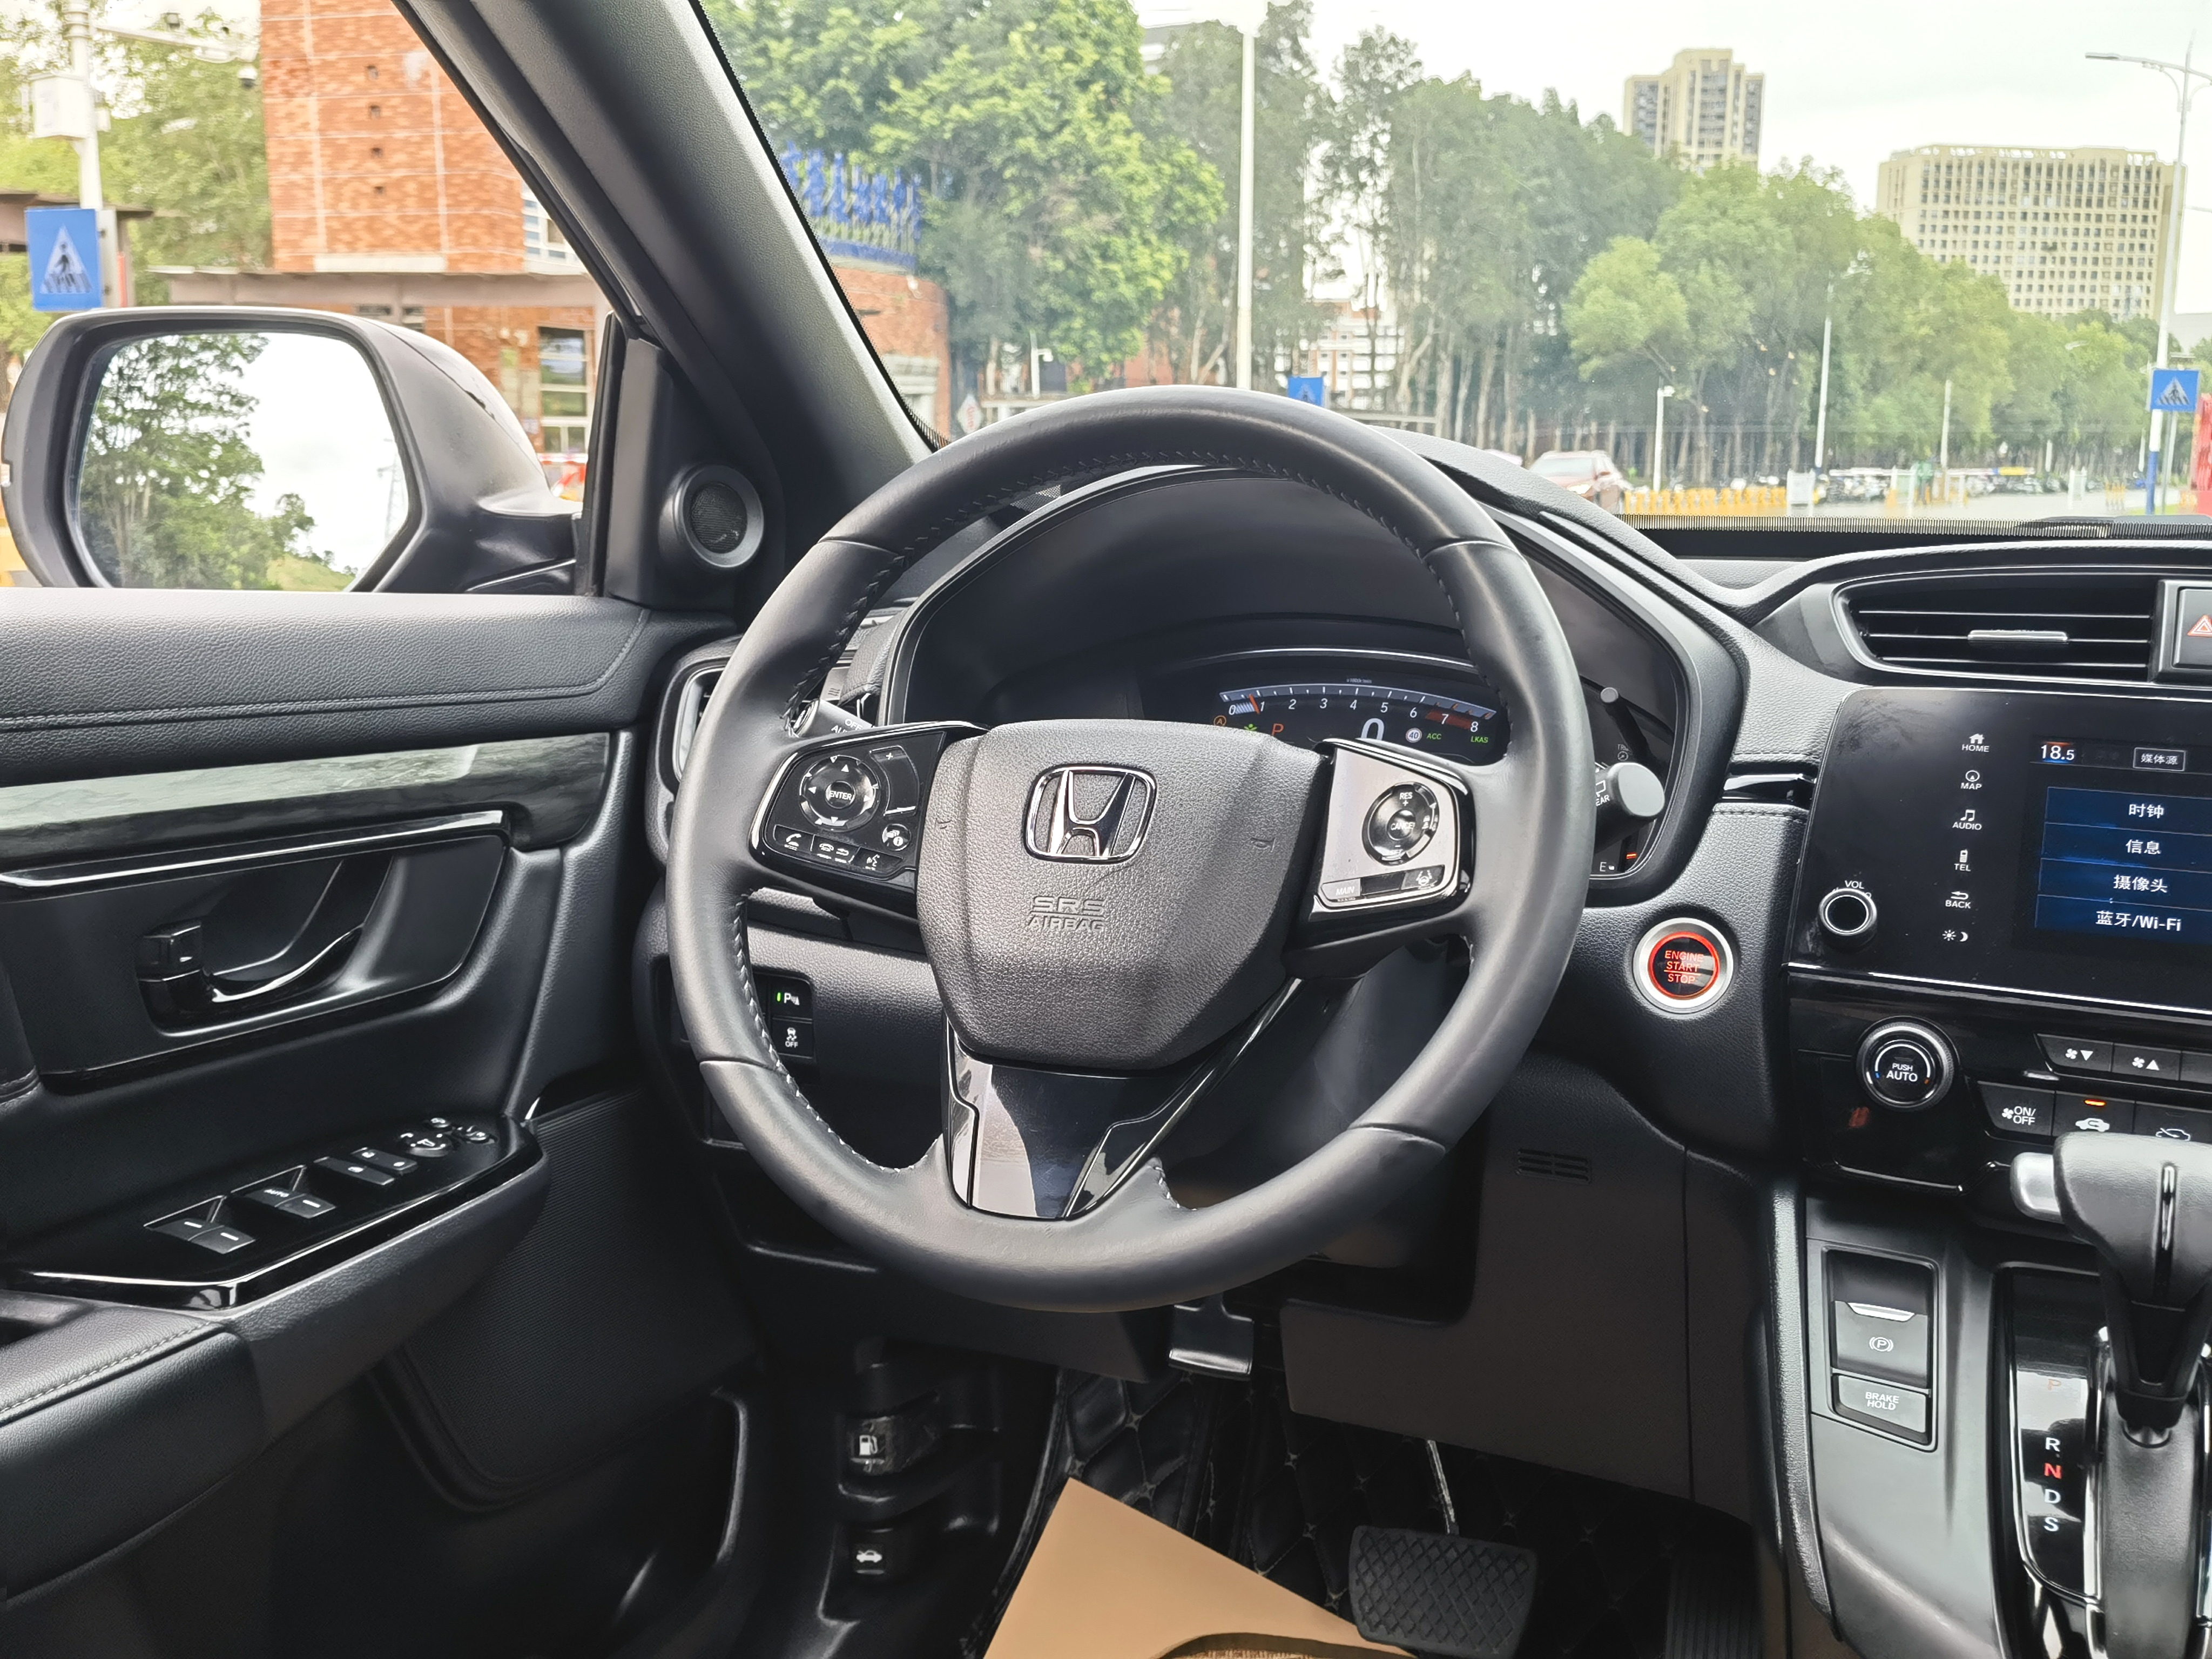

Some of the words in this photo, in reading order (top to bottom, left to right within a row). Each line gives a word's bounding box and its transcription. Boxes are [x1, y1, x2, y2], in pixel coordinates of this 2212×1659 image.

[1229, 704, 1236, 715] 0
[1260, 701, 1265, 712] 1
[1288, 698, 1297, 710] 2
[1319, 698, 1327, 709] 3
[1350, 699, 1358, 710] 4
[1380, 702, 1388, 713] 5
[1410, 707, 1418, 718] 6
[1441, 713, 1449, 724] 7
[1471, 721, 1479, 732] 8
[845, 718, 863, 731] OFF
[1272, 723, 1284, 736] P
[1409, 731, 1418, 740] 40
[1962, 744, 1990, 753] HOME
[2040, 744, 2075, 761] 18.5
[2141, 753, 2179, 765] 媒体源
[1960, 783, 1982, 791] MAP
[829, 791, 852, 801] ENTER
[1399, 792, 1413, 800] RES
[1595, 794, 1610, 806] EAR
[2129, 803, 2164, 819] 时钟
[1952, 821, 1982, 831] AUDIO
[2126, 839, 2162, 855] 信息
[1600, 861, 1607, 872] E
[1954, 863, 1972, 872] TEL
[1844, 880, 1865, 889] VOL
[2113, 874, 2168, 894] 摄像头
[1336, 886, 1355, 896] MAIN
[1033, 895, 1105, 915] SRS
[1945, 900, 1971, 909] BACK
[1028, 916, 1105, 933] AIRBAG
[2095, 910, 2182, 932] 蓝牙/Wi-Fi
[1664, 950, 1704, 962] ENGINE
[1667, 961, 1700, 972] START
[1668, 973, 1696, 984] STOP
[1892, 1062, 1913, 1072] PUSH
[1886, 1070, 1918, 1083] AUTO
[2013, 1114, 2035, 1126] OFF
[2048, 1379, 2061, 1391] P
[1865, 1392, 1899, 1404] BRAKE
[1867, 1400, 1896, 1411] HOLD
[2045, 1437, 2061, 1452] R
[2044, 1462, 2062, 1480] N
[2044, 1488, 2061, 1504] D
[2044, 1516, 2060, 1532] S
